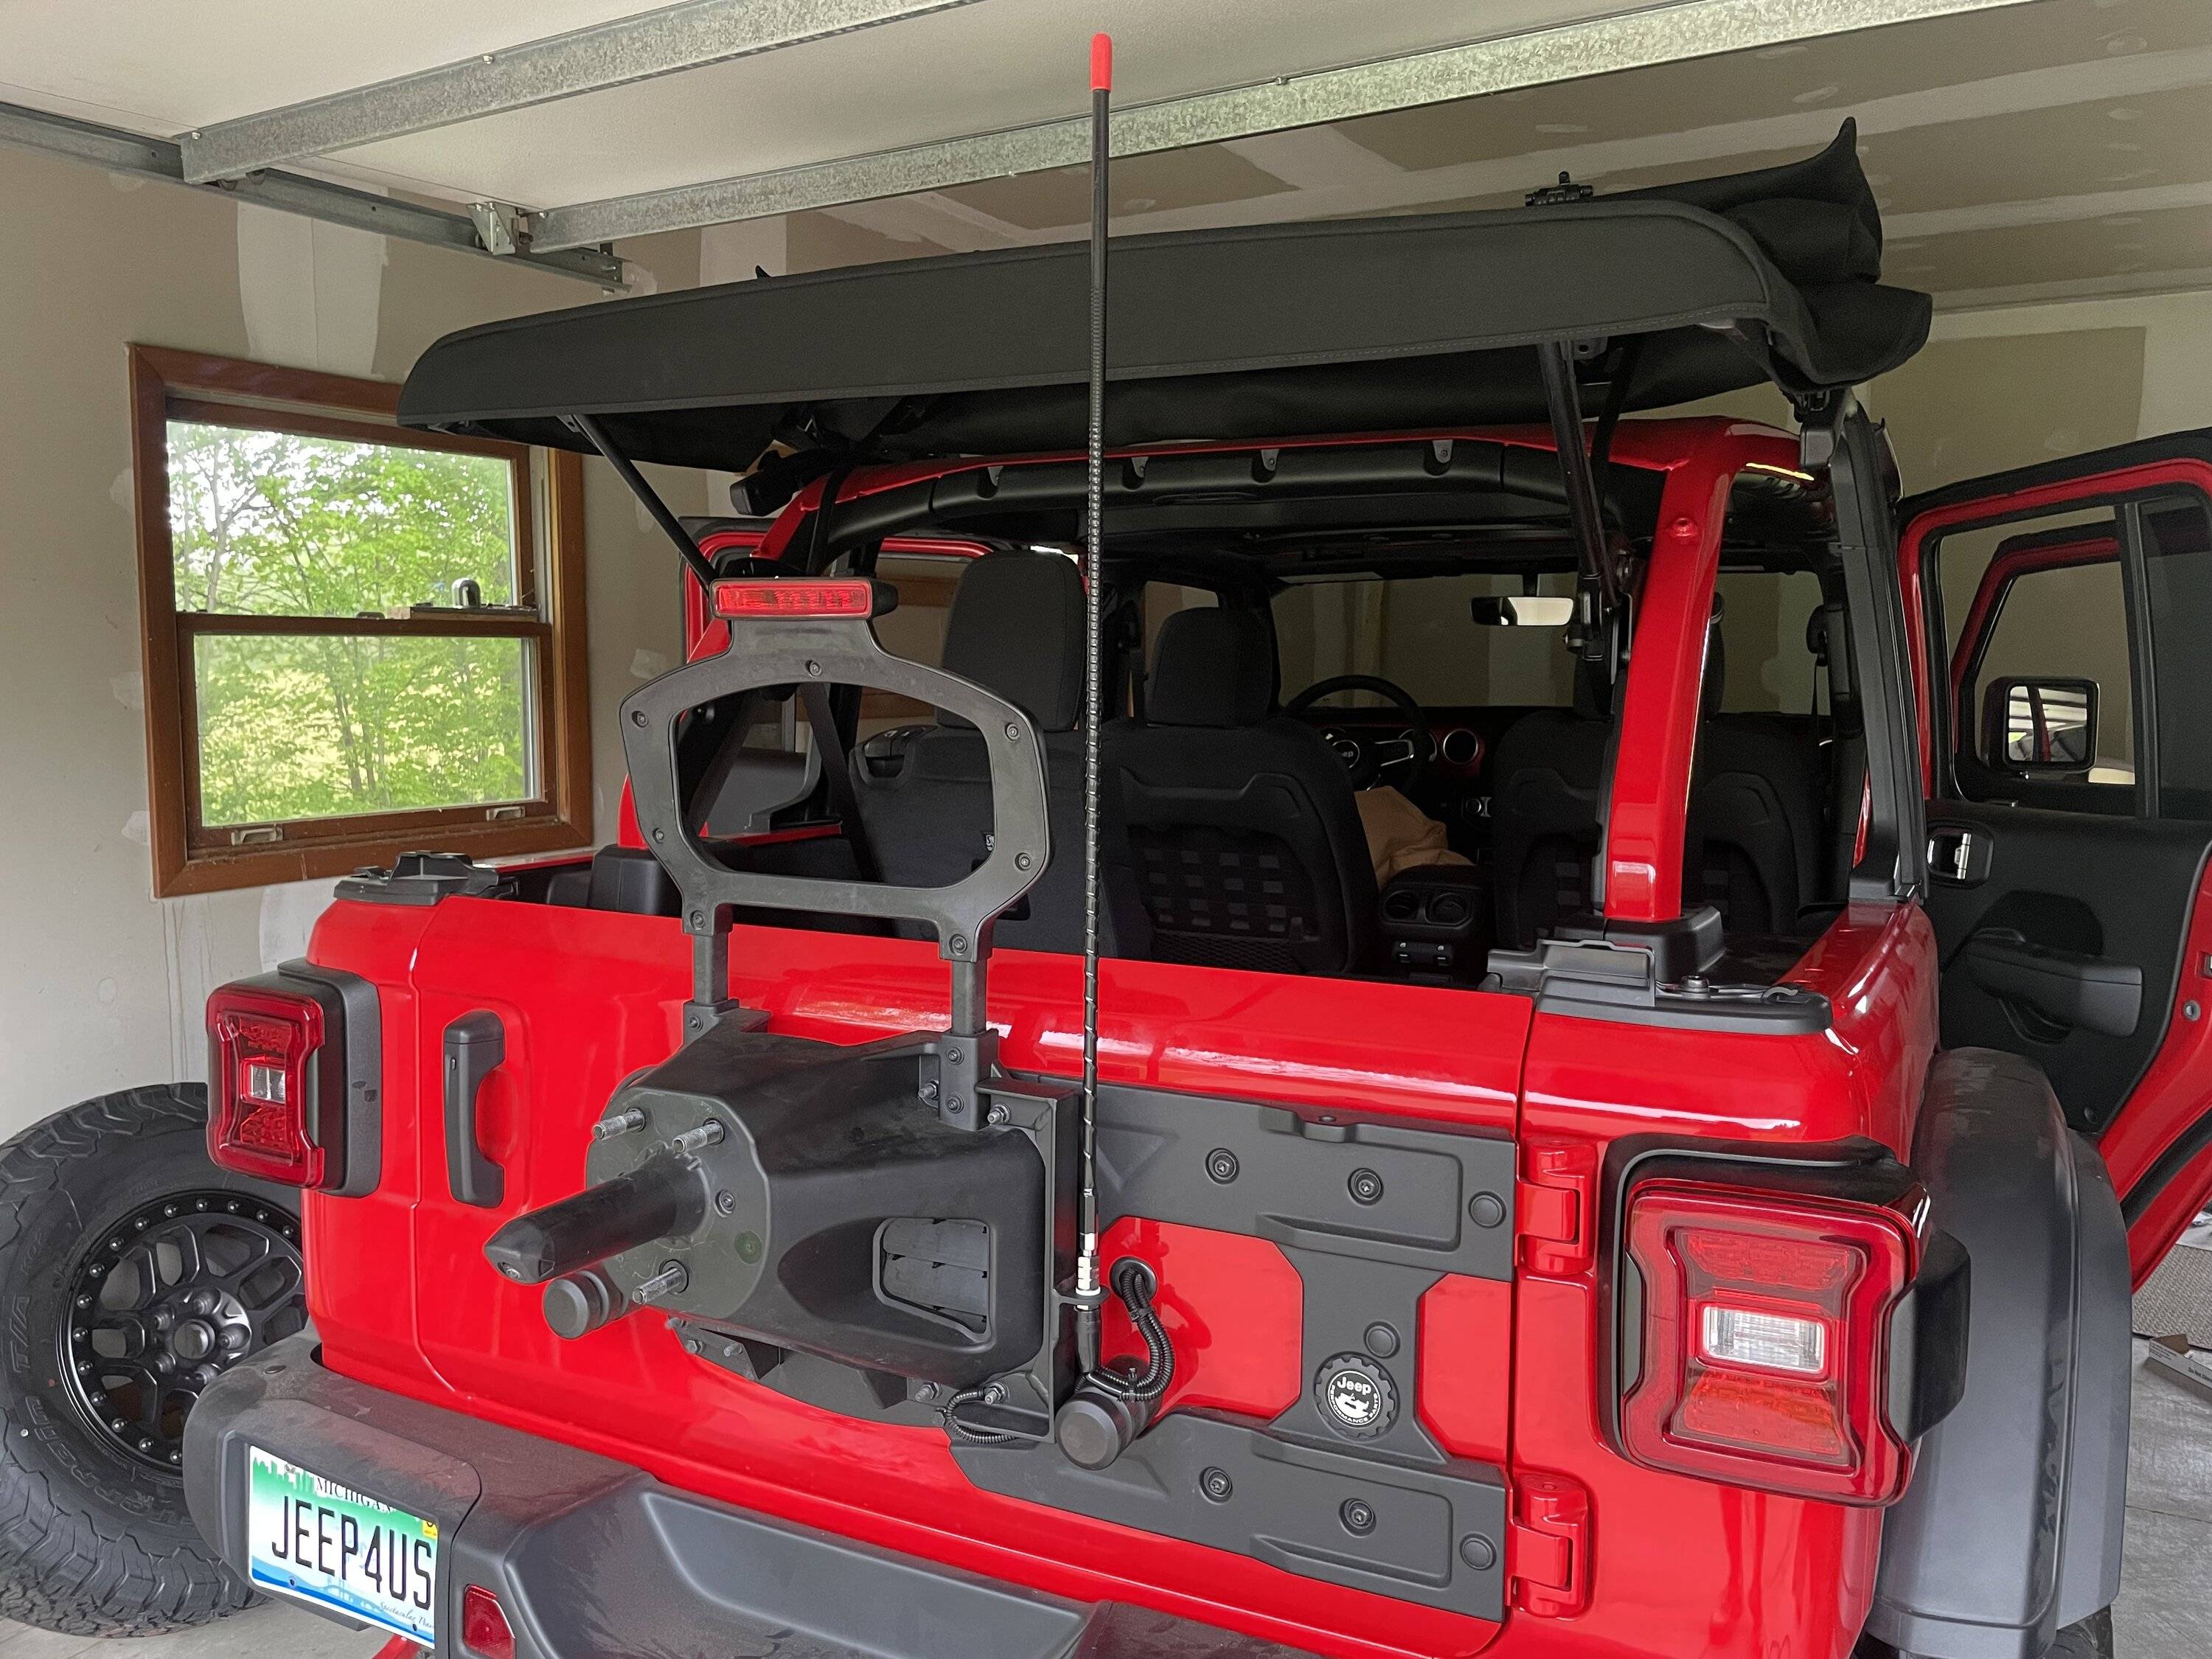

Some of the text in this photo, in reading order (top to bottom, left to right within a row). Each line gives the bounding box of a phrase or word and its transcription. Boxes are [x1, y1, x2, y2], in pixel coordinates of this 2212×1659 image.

[9, 1293, 32, 1373] T/A
[1330, 1384, 1379, 1423] PERFORMANCE PARTS
[1337, 1377, 1371, 1396] Jeep
[317, 1478, 394, 1513] MICHIGAN
[271, 1495, 431, 1610] JEEP4US
[380, 1601, 416, 1621] Spectacular
